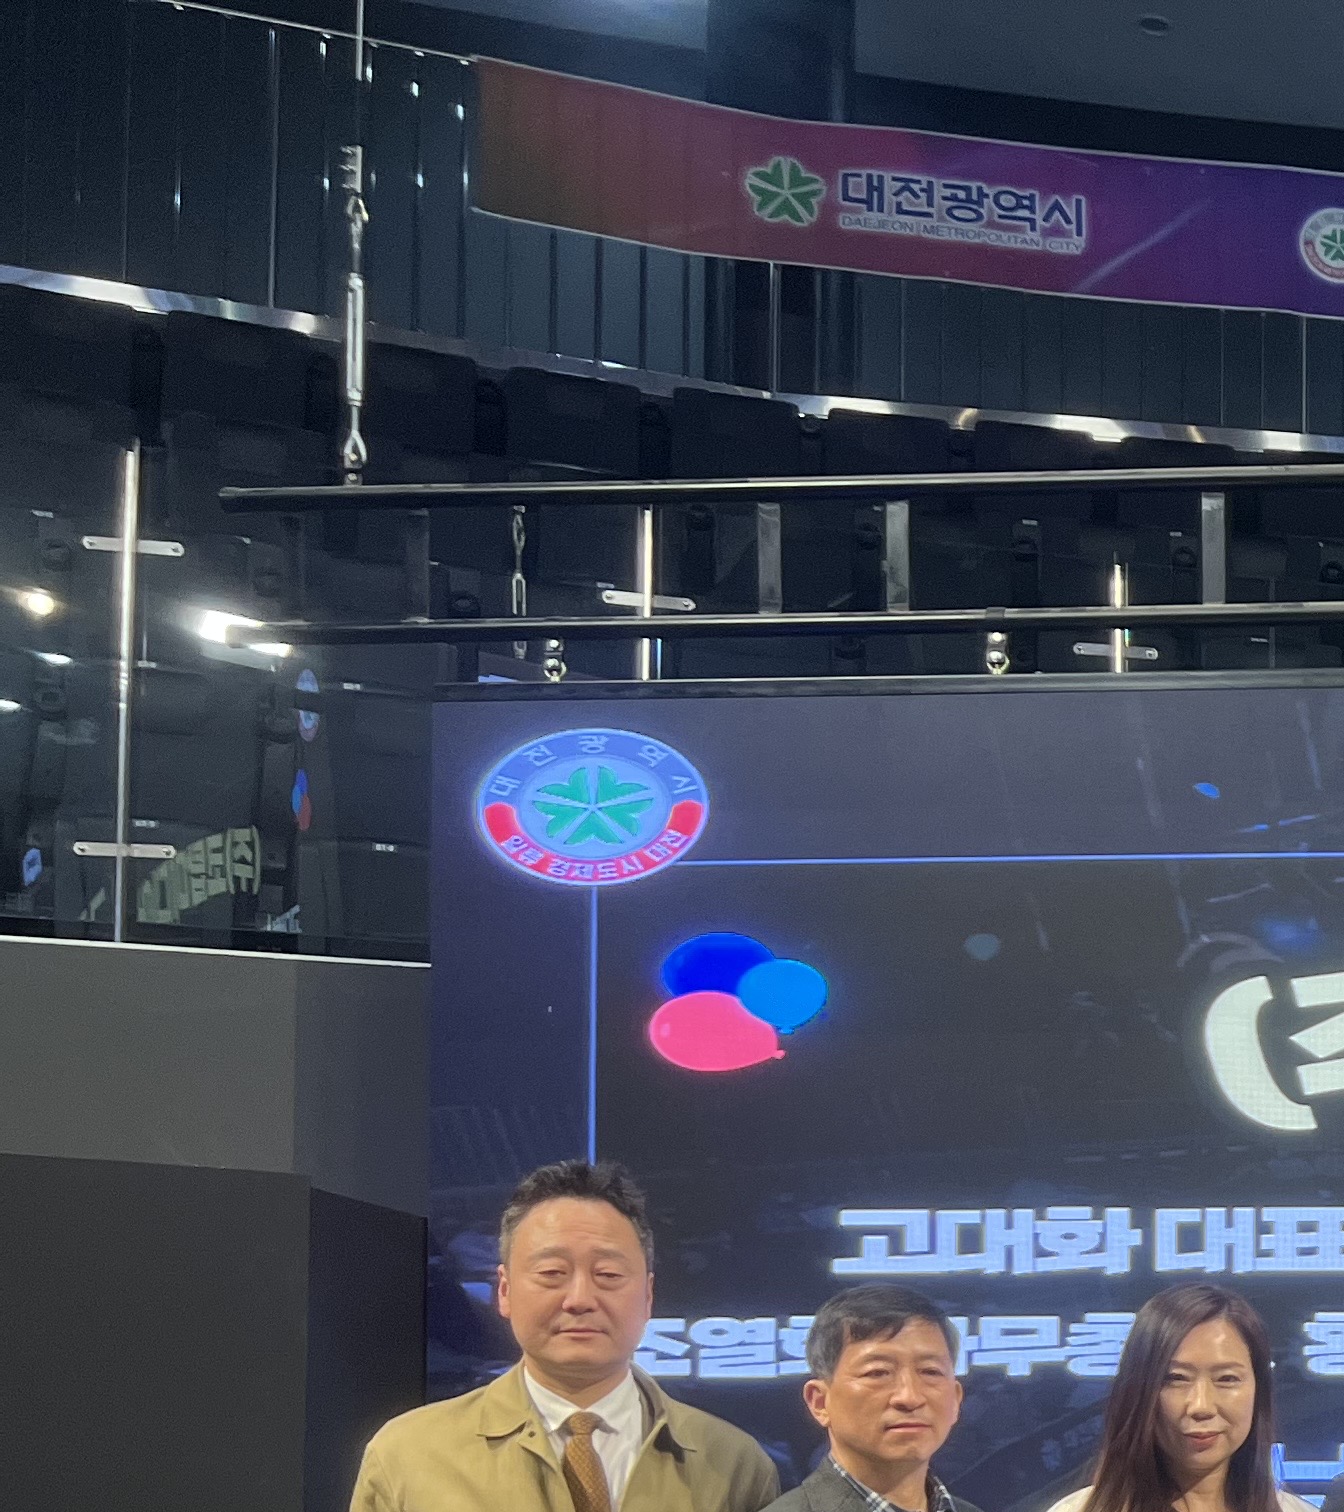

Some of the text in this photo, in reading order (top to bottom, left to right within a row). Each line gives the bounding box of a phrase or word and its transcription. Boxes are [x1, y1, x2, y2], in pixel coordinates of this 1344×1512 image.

[841, 171, 1084, 238] 대전광역시
[841, 214, 1083, 253] DAEJEON METROPOLITAN CITY
[489, 734, 699, 798] 대전광역시
[831, 1206, 1143, 1275] 고대화
